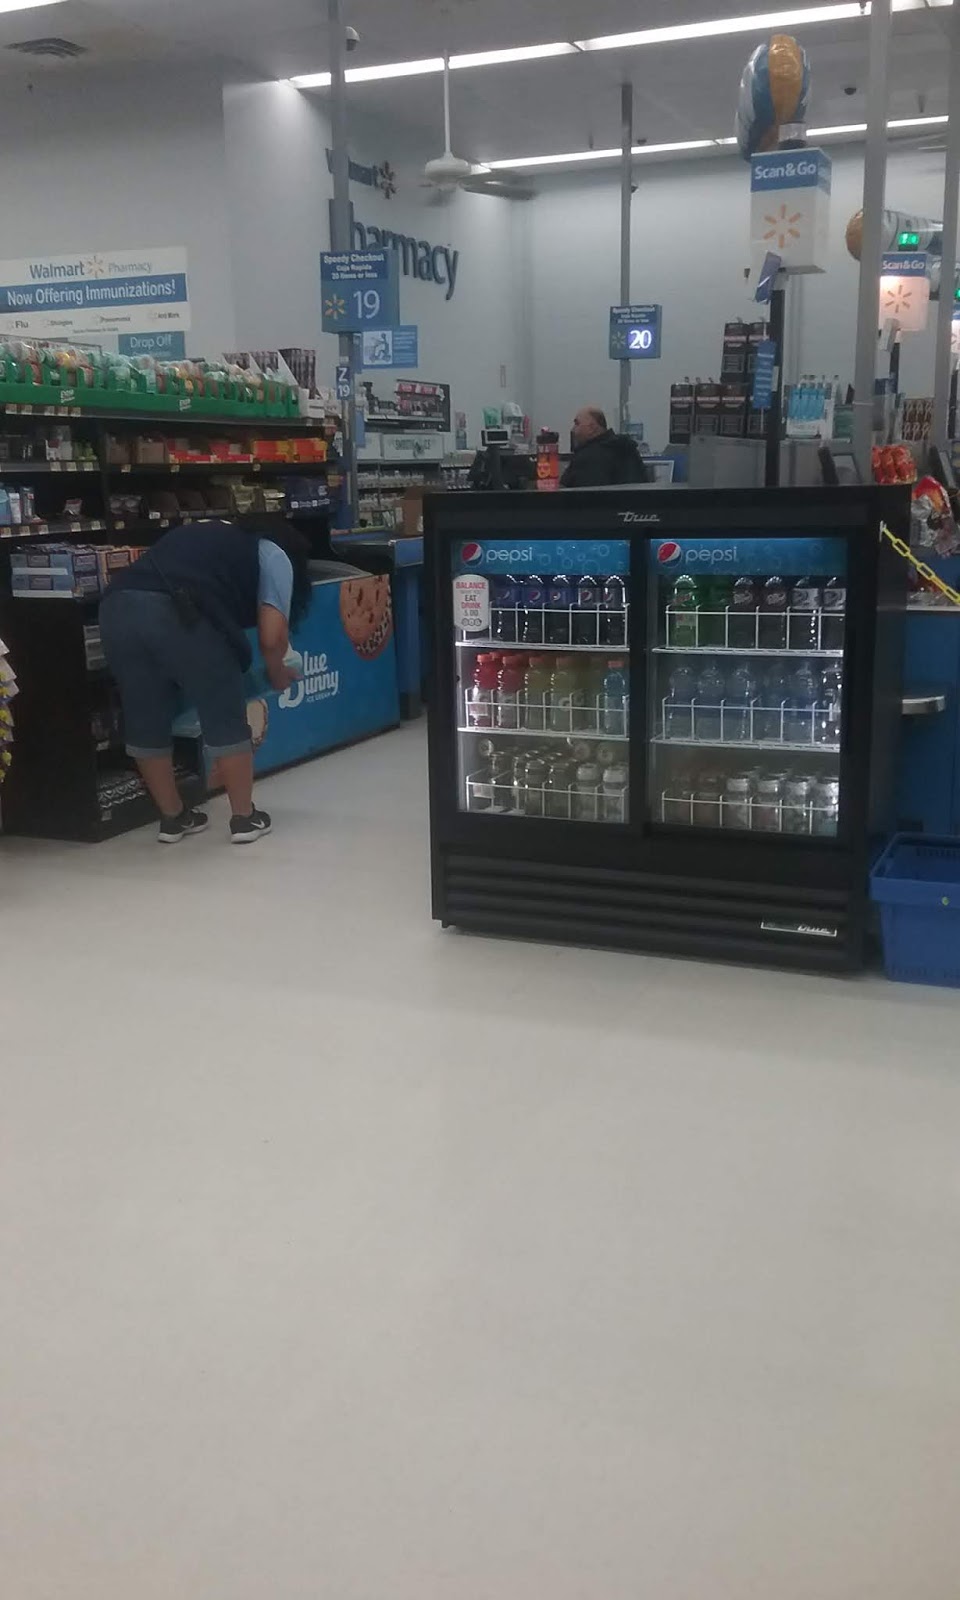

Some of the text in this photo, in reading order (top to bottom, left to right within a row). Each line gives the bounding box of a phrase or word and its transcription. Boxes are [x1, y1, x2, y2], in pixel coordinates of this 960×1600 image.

[754, 161, 817, 180] Scan&Go
[324, 253, 384, 264] Speedy Checkout
[882, 259, 925, 270] Scan&Go
[29, 260, 152, 280] Walmart Pharmacy
[7, 278, 177, 306] Now Offering Immunizations!
[353, 290, 380, 319] 19
[15, 320, 29, 329] Flu
[130, 334, 172, 350] Drop Off
[629, 329, 652, 349] 20
[338, 367, 348, 382] Z
[338, 384, 350, 397] 19
[617, 511, 660, 523] True
[486, 547, 533, 564] pepsi
[685, 546, 738, 565] pepsi
[456, 581, 486, 589] BALANCE
[464, 594, 477, 602] EAT
